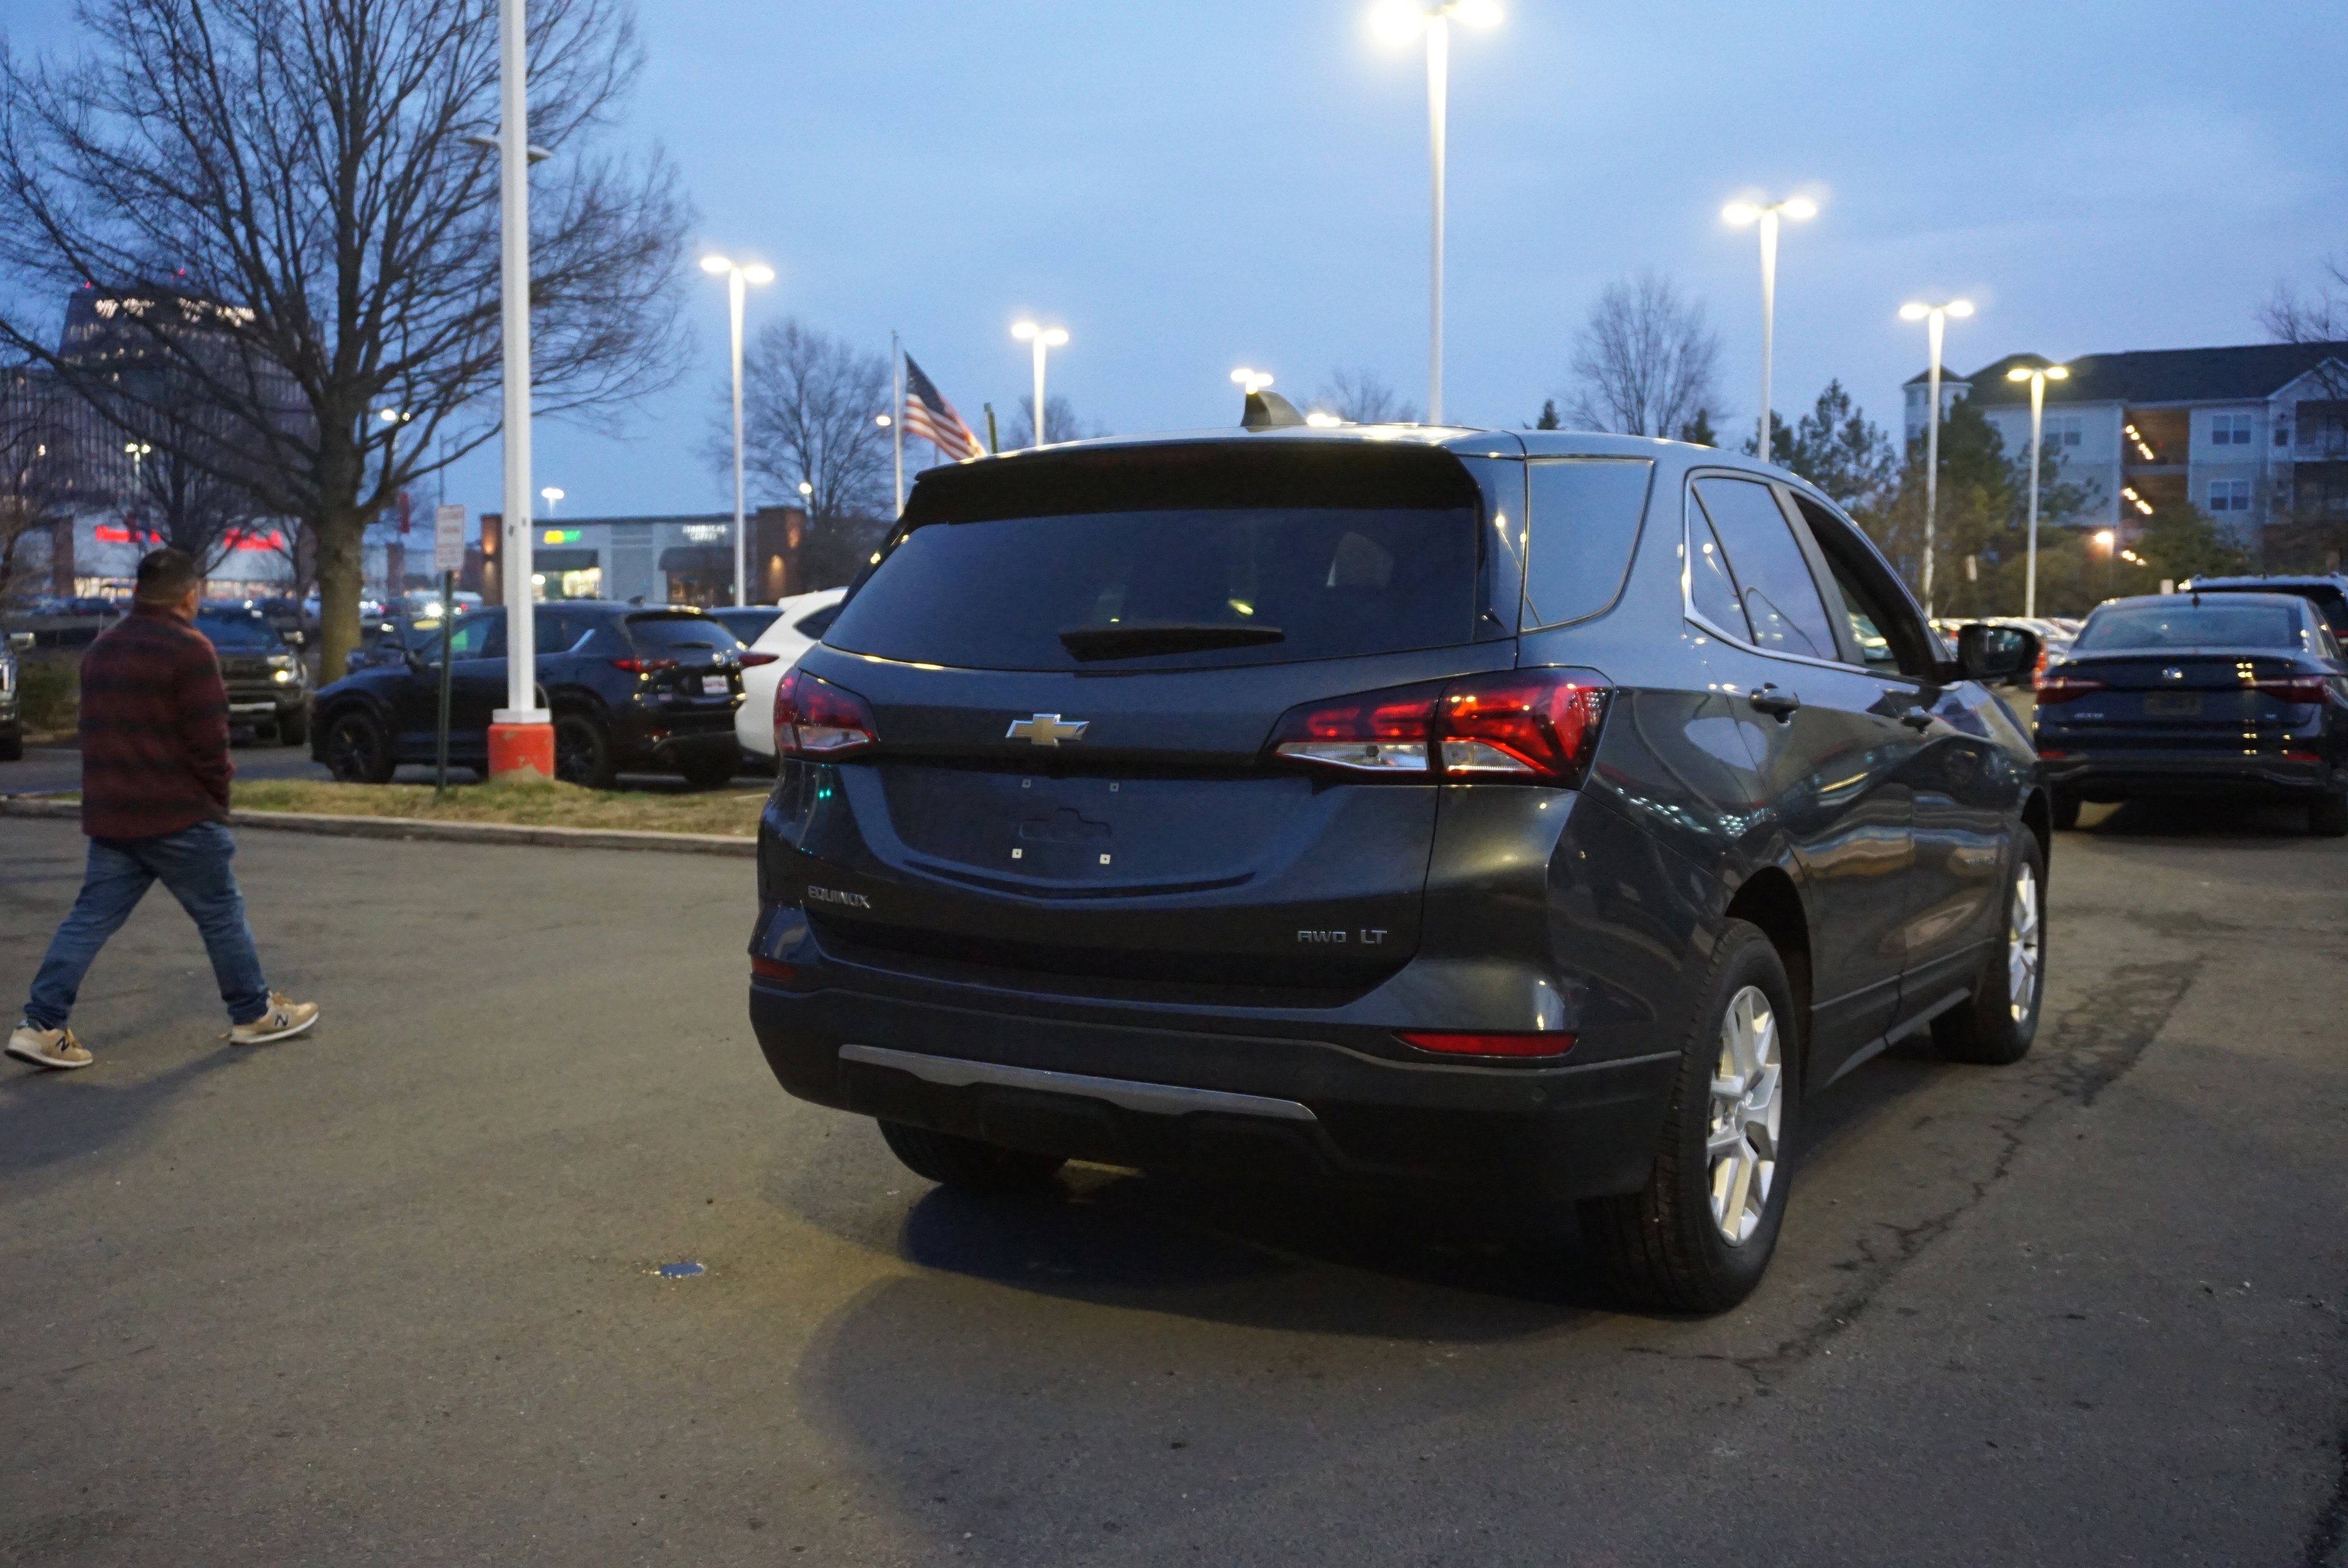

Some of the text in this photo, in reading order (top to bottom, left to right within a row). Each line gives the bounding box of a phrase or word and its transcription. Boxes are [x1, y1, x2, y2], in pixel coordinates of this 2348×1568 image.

[808, 886, 871, 909] EQUINOX
[1297, 930, 1387, 943] AWD LT
